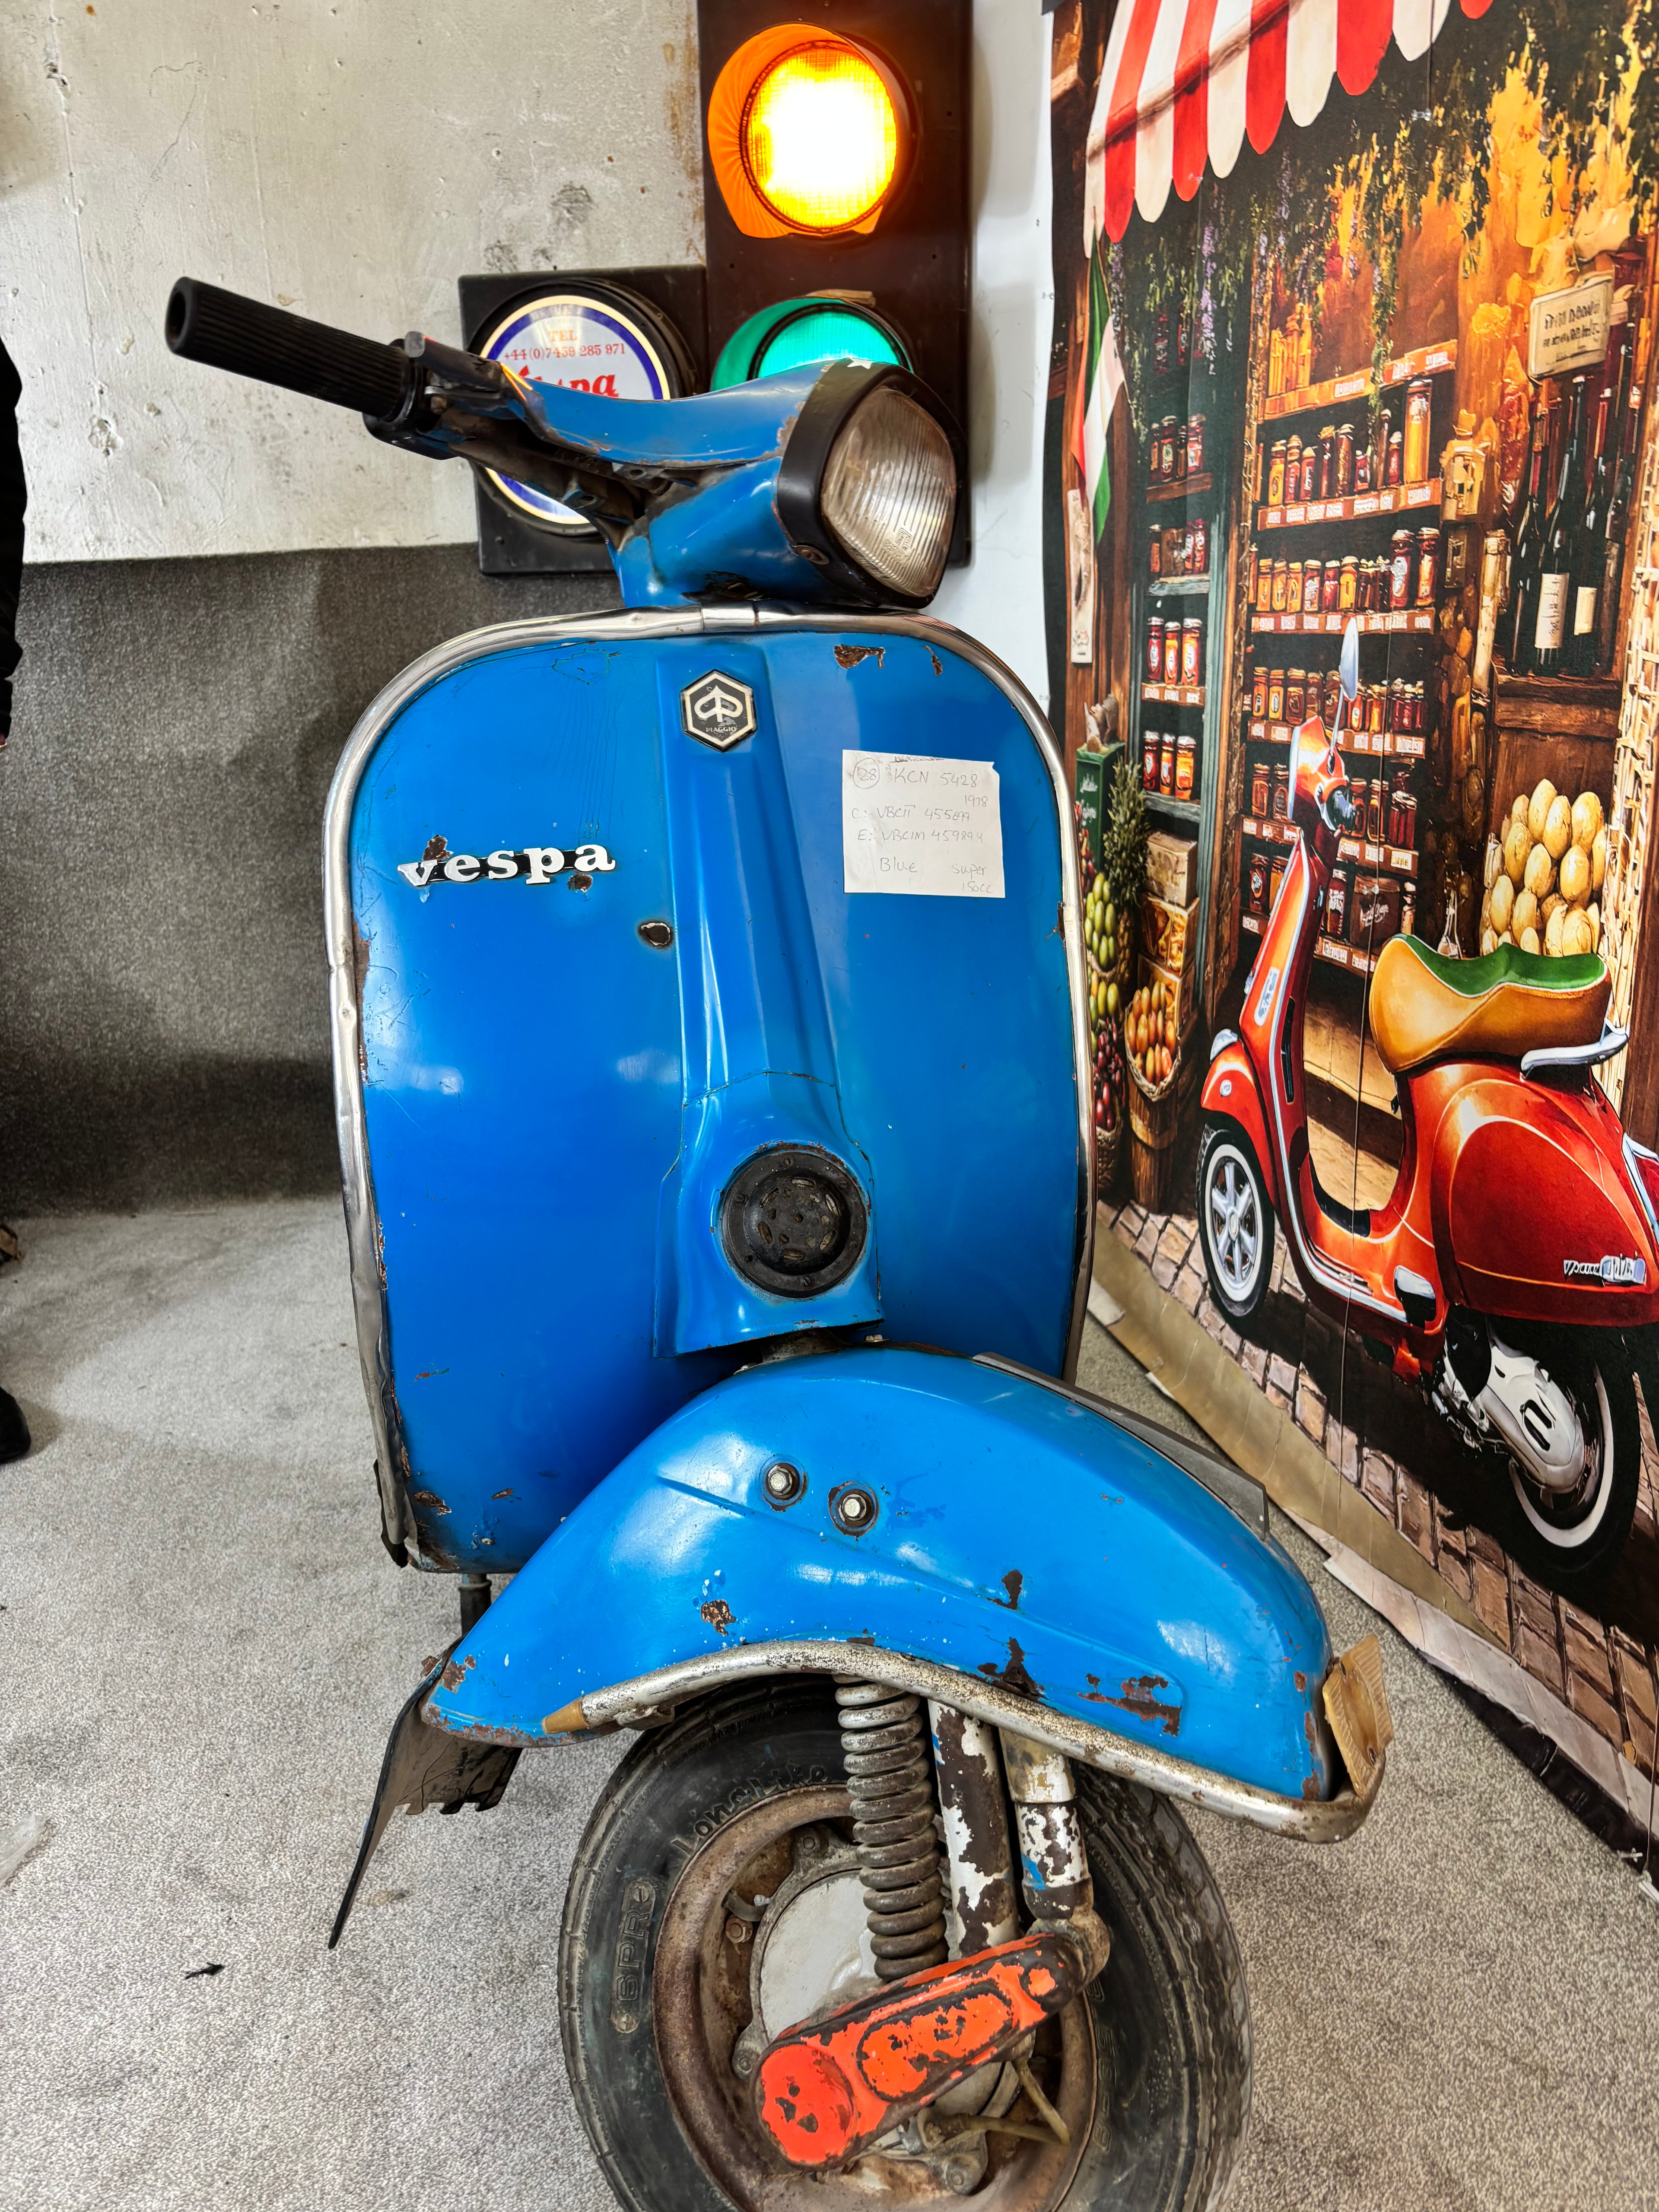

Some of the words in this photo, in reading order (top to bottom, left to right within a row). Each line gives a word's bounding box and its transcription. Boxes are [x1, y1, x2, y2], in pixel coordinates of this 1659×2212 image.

[548, 330, 578, 342] TEL
[579, 344, 602, 356] 285
[605, 343, 625, 355] 971
[894, 767, 929, 784] KCN
[940, 773, 978, 788] 5428
[965, 795, 988, 808] 1978
[397, 843, 616, 887] vespa
[880, 857, 918, 873] Blue
